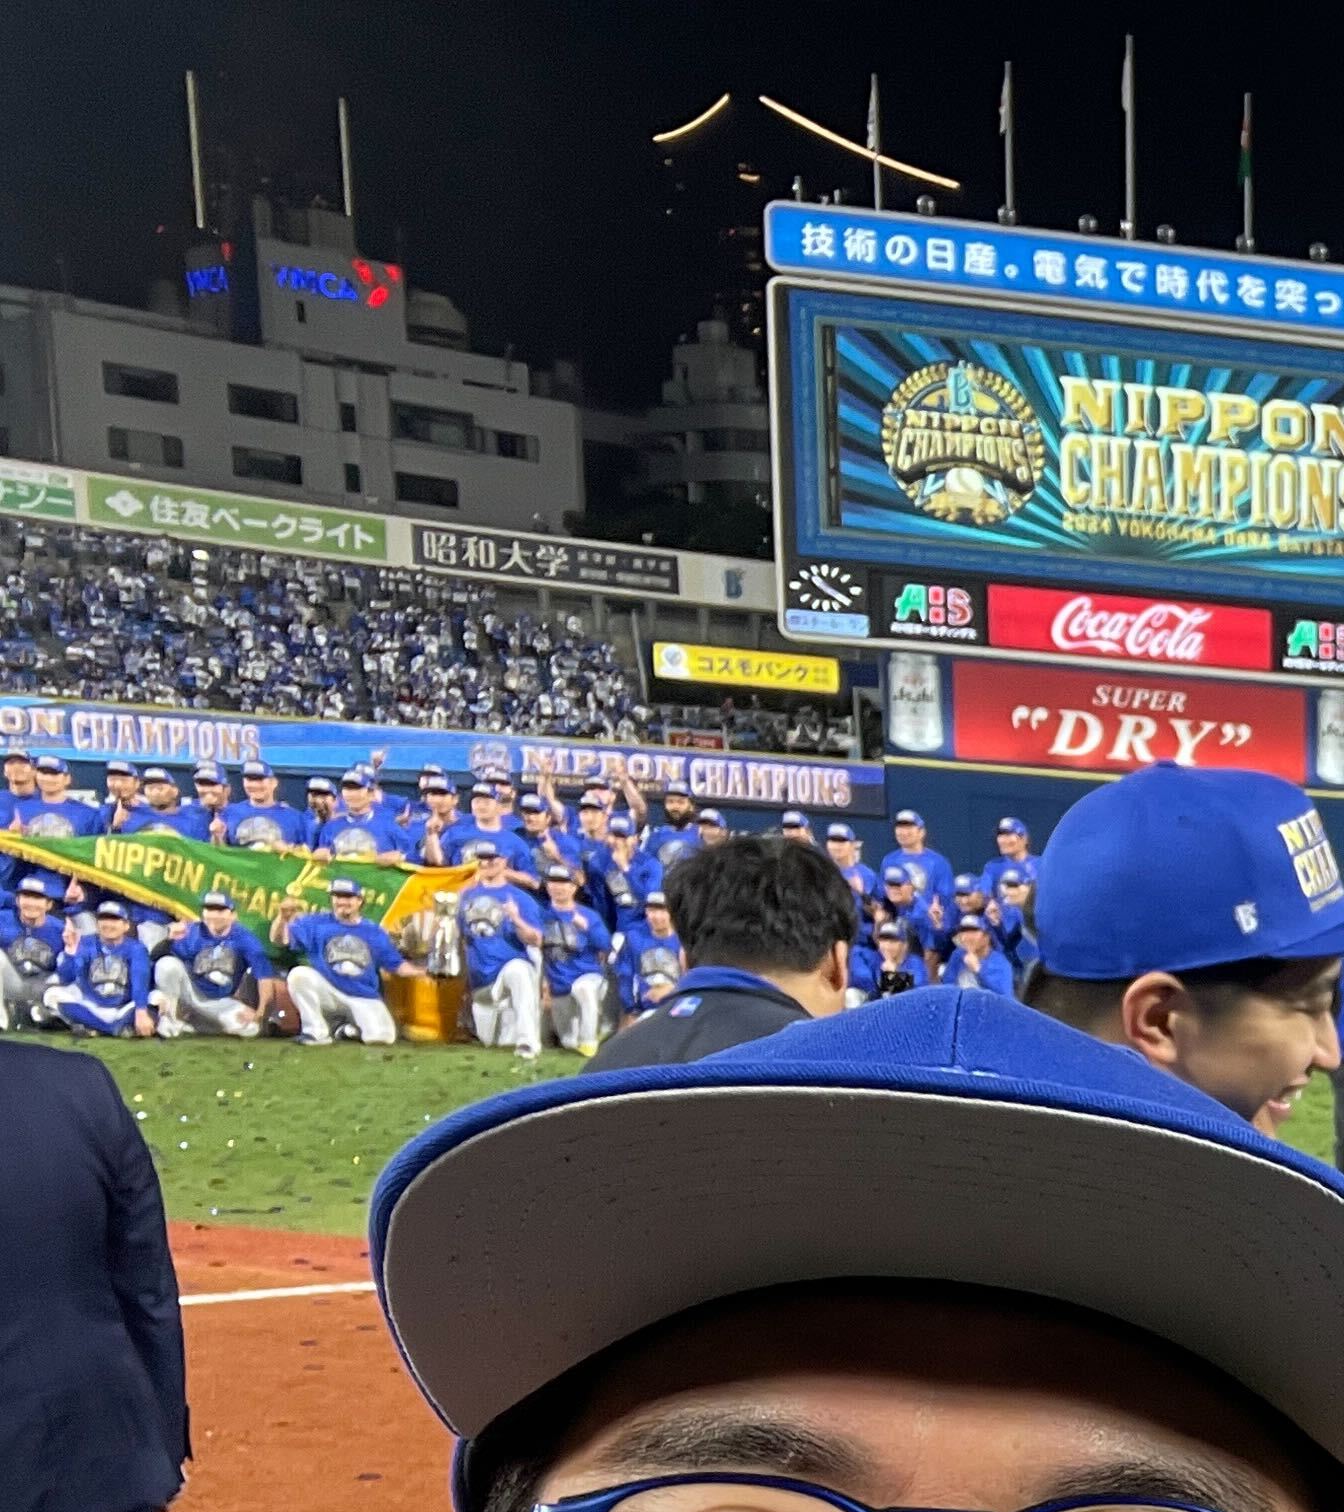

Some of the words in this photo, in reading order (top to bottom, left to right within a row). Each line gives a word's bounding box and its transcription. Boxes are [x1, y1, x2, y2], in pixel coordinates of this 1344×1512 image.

[904, 408, 1023, 438] NIPPON
[896, 428, 1031, 484] CHAMPIONS
[150, 494, 375, 550] 住友ベークライト
[421, 530, 569, 578] 昭和大学
[1051, 596, 1213, 661] Coca-Cola
[1092, 684, 1188, 714] SUPER
[0, 706, 66, 736] ON
[71, 710, 261, 761] CHAMPIONS
[689, 757, 852, 807] CHAMPIONS
[94, 837, 205, 893] NIPPON
